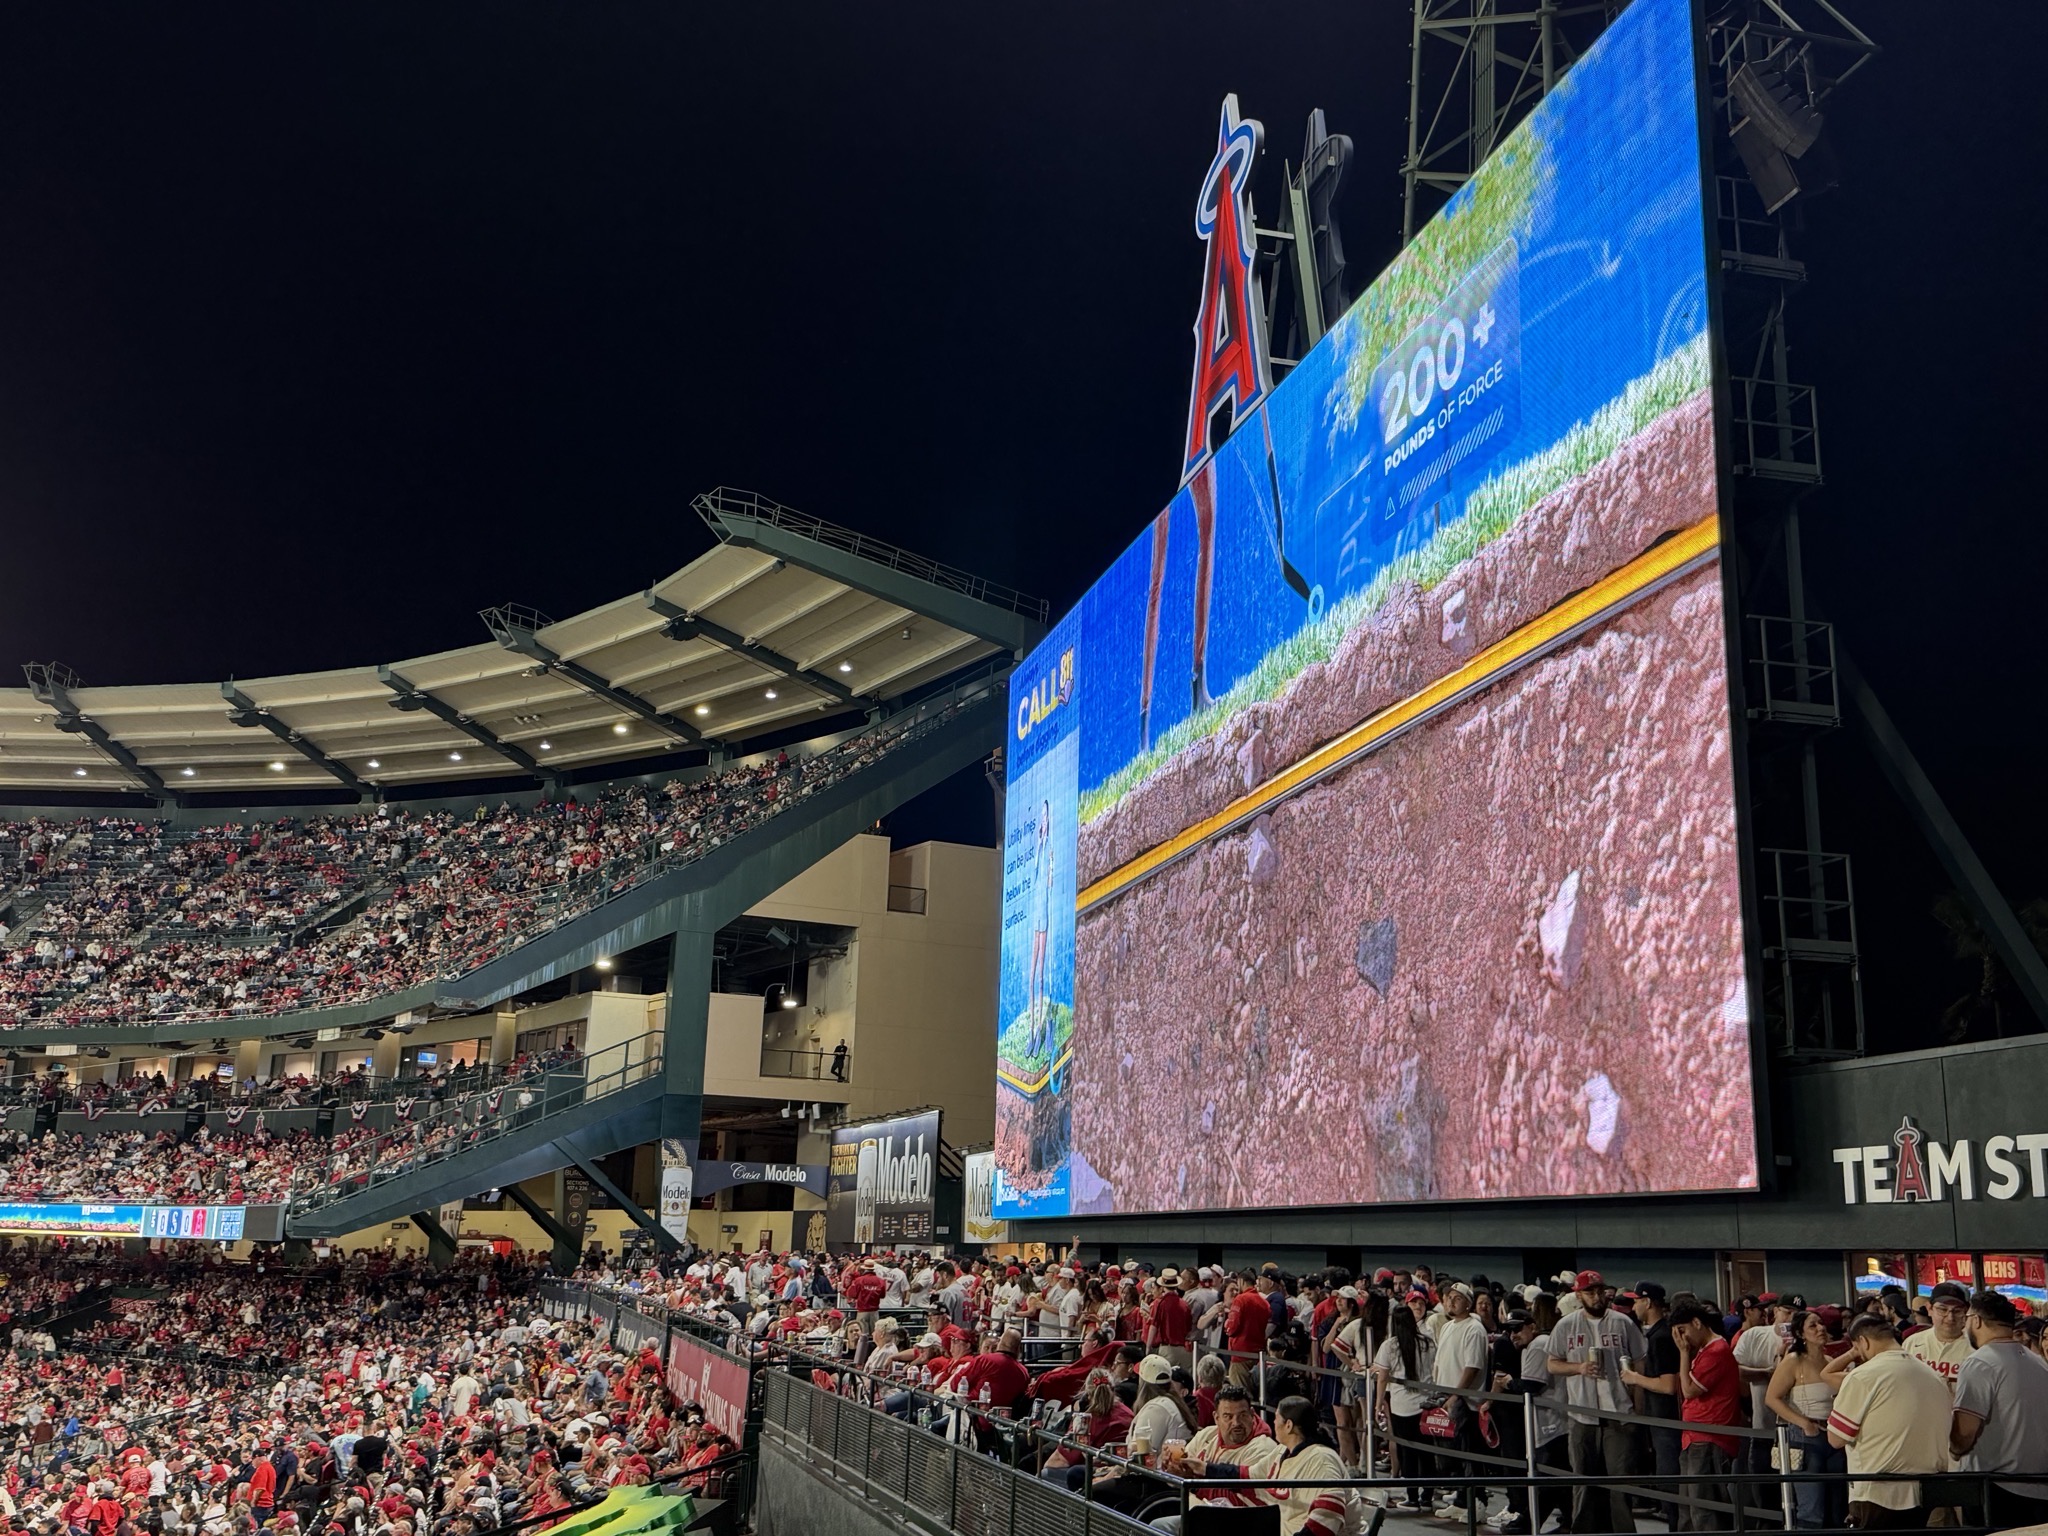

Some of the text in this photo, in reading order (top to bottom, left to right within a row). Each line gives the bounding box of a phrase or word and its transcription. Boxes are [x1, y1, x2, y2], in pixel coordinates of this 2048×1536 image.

[1384, 302, 1496, 445] 200+
[1384, 358, 1503, 476] POUNDS OF FORCE
[1017, 667, 1060, 741] CALL
[1005, 884, 1021, 903] below
[730, 1162, 807, 1183] Casa Modelo
[830, 1155, 858, 1176] FIGHTER
[876, 1133, 933, 1205] Modelo
[1833, 1115, 1974, 1205] TEAM
[1956, 1259, 2017, 1279] WMENS
